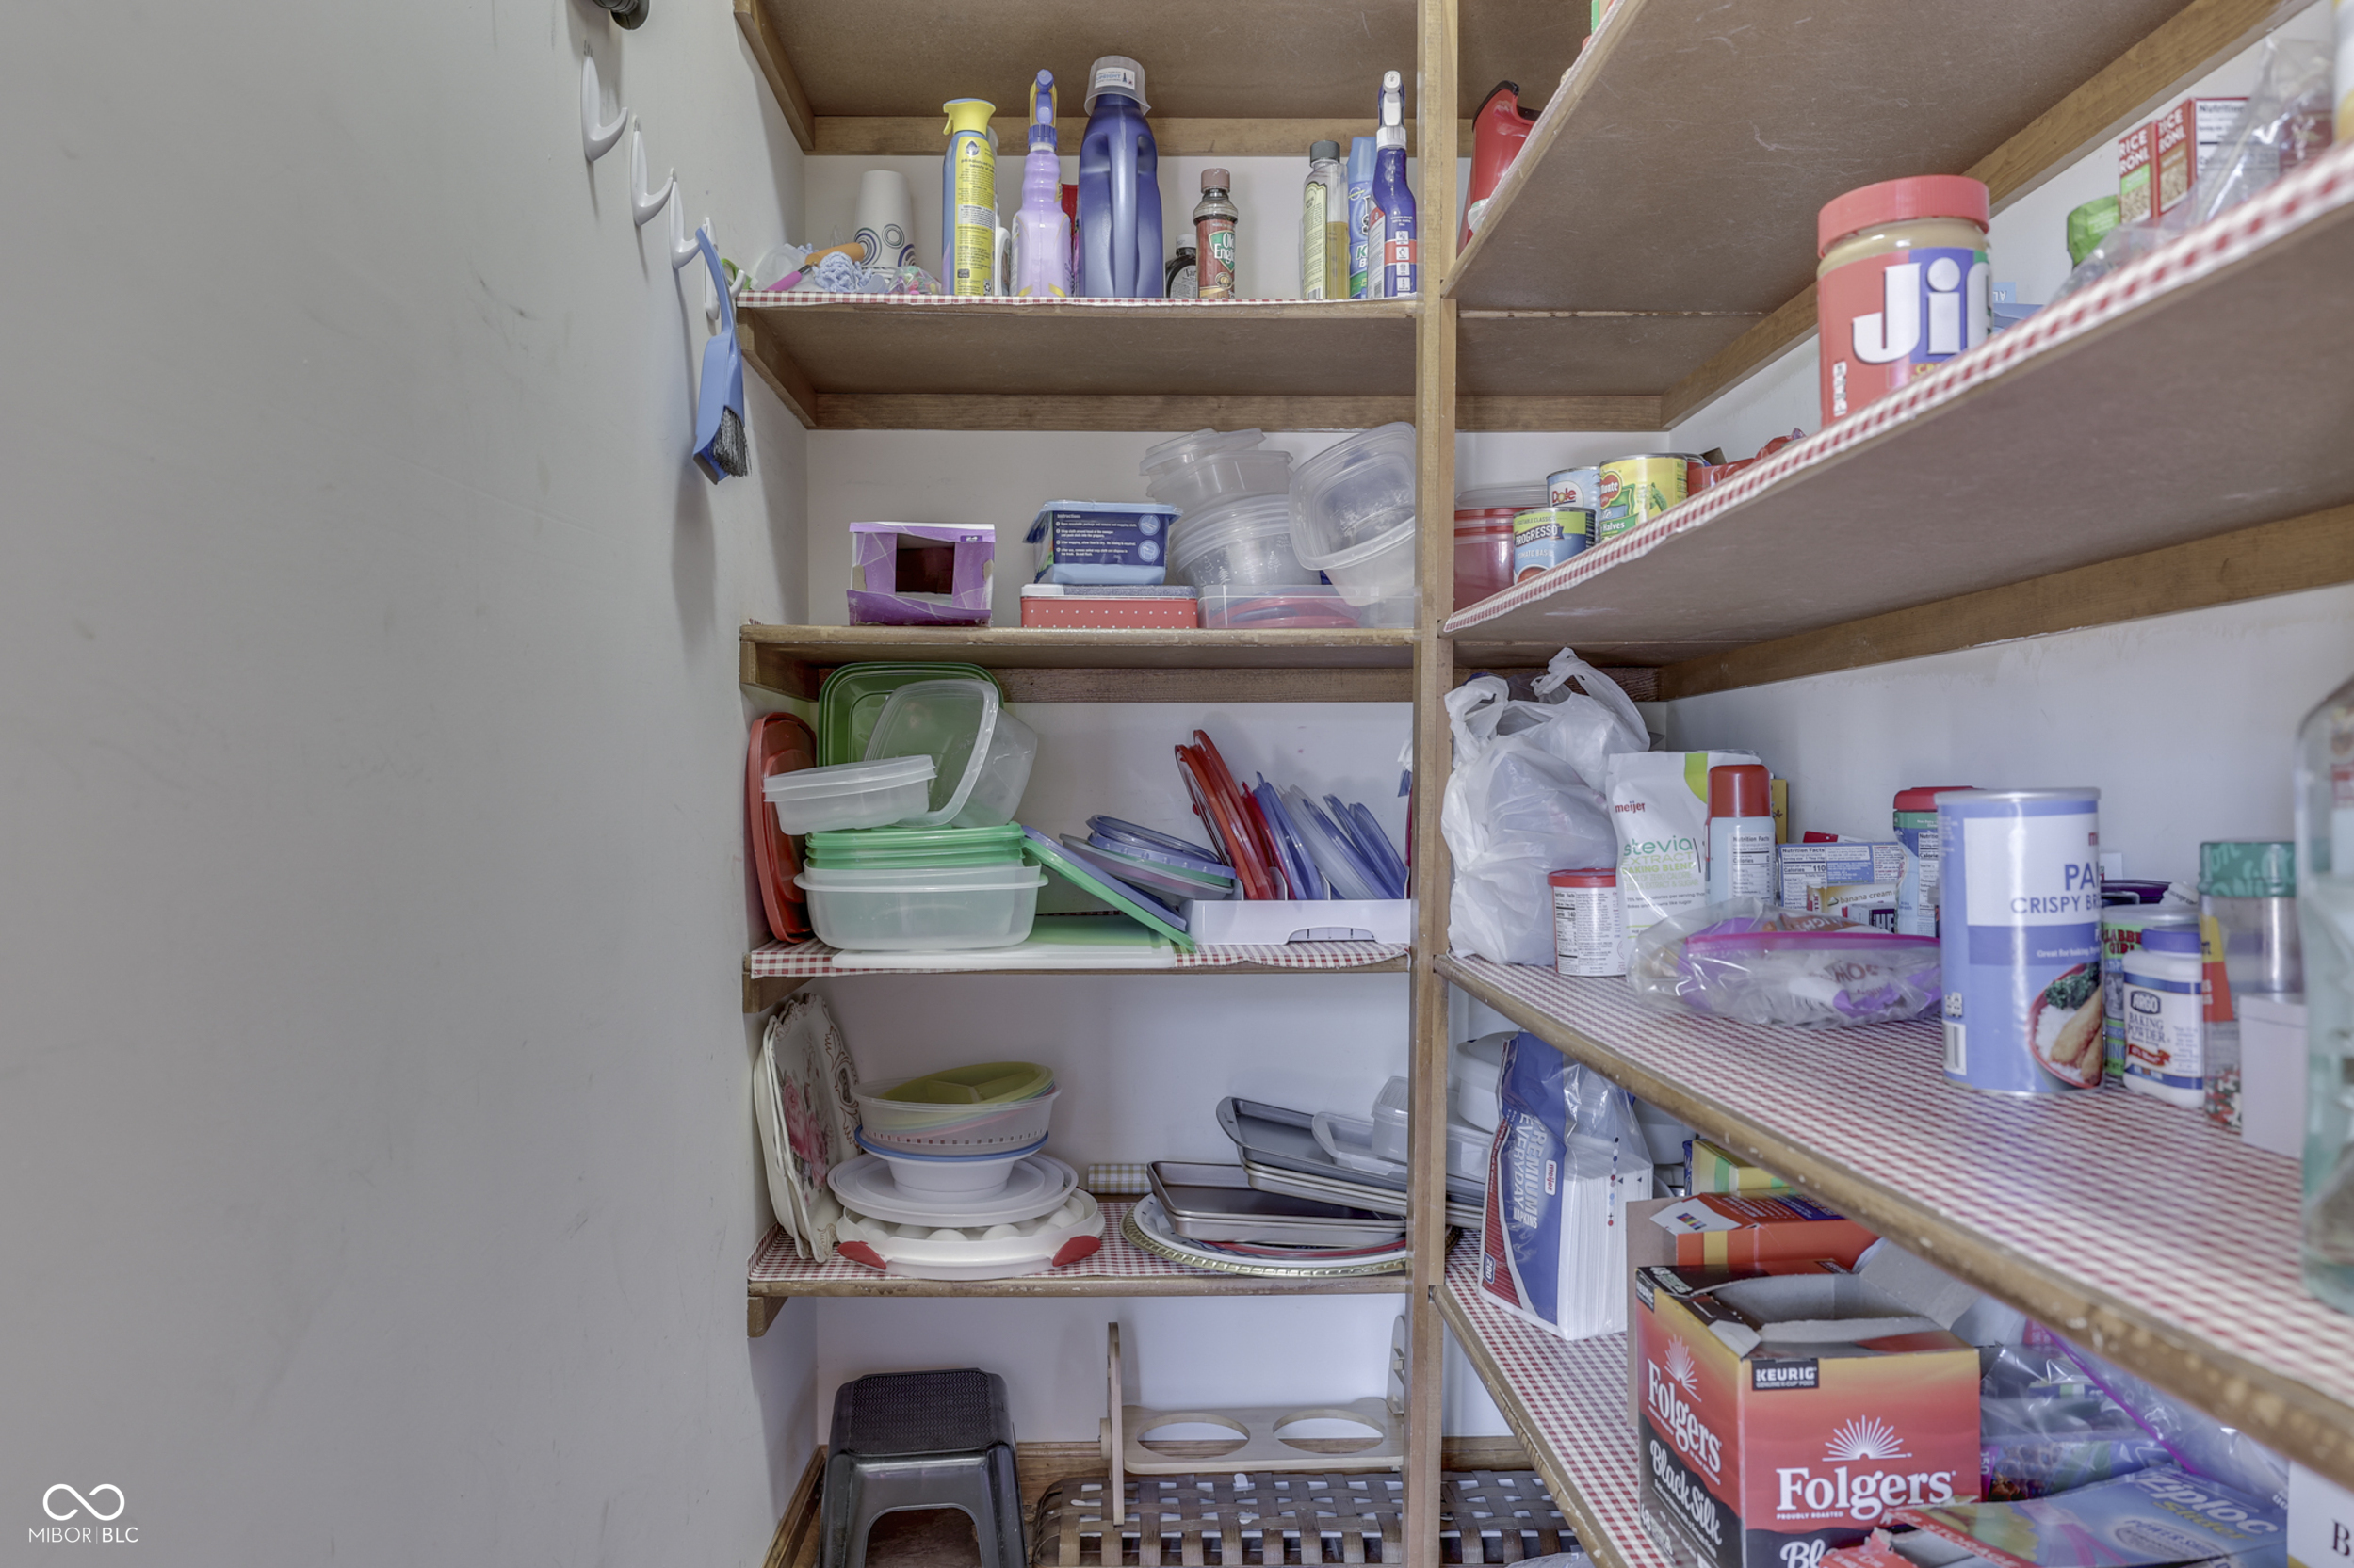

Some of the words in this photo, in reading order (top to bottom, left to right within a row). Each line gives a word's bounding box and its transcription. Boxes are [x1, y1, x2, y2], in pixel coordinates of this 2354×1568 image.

[2119, 129, 2148, 155] RICE
[2119, 147, 2150, 175] RONI
[1992, 291, 2006, 302] AL
[1552, 487, 1577, 504] Dole
[1515, 525, 1558, 546] PROGRESSO
[1602, 522, 1625, 532] Halves
[1615, 800, 1646, 814] meijer
[1623, 834, 1693, 857] stevia
[1621, 851, 1694, 866] EXTRACT
[1663, 861, 1697, 872] BLEND
[1840, 892, 1867, 903] banana
[1869, 890, 1892, 899] cream
[2010, 895, 2081, 914] CRISPY
[2037, 949, 2058, 958] Great
[2132, 992, 2159, 1014] ARGO
[2129, 1011, 2164, 1030] BAKING
[2128, 1023, 2167, 1043] POWDER
[1513, 1112, 1534, 1209] EVERYDAY
[1524, 1117, 1548, 1216] PREMIUM
[1485, 1258, 1495, 1280] 200
[1756, 1366, 1816, 1382] KEURIG
[1648, 1358, 1722, 1474] Folgers
[1649, 1439, 1691, 1511] Black
[1690, 1485, 1723, 1546] Silk
[1776, 1465, 1955, 1521] Folgers
[2135, 1475, 2279, 1534] Ziploc
[1810, 1511, 1844, 1519] ROASTED
